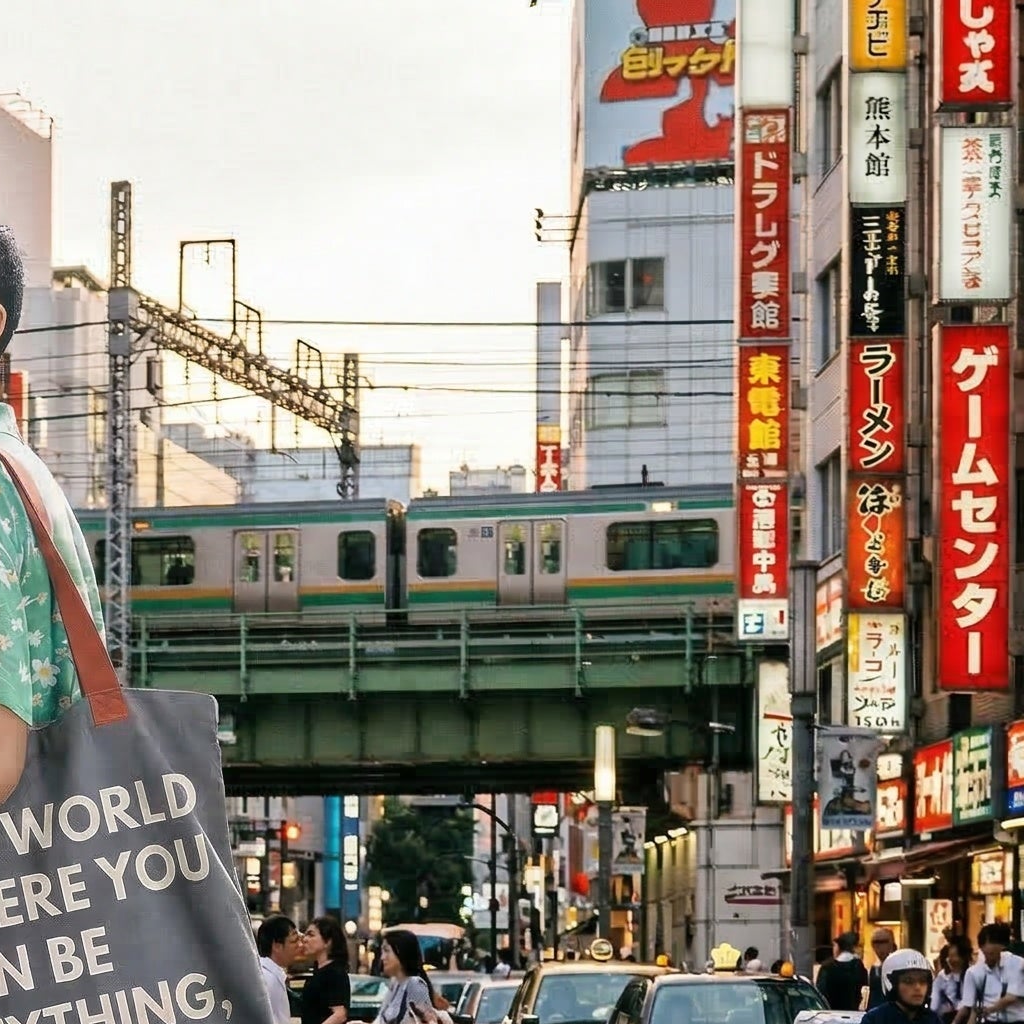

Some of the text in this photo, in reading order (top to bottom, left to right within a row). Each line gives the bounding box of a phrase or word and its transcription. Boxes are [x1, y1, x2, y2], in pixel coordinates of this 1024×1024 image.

[865, 96, 893, 177] 熊本館
[859, 345, 894, 467] ラーメン
[951, 344, 999, 674] ゲームセンター
[94, 834, 210, 901] YOU
[46, 926, 114, 984] BE
